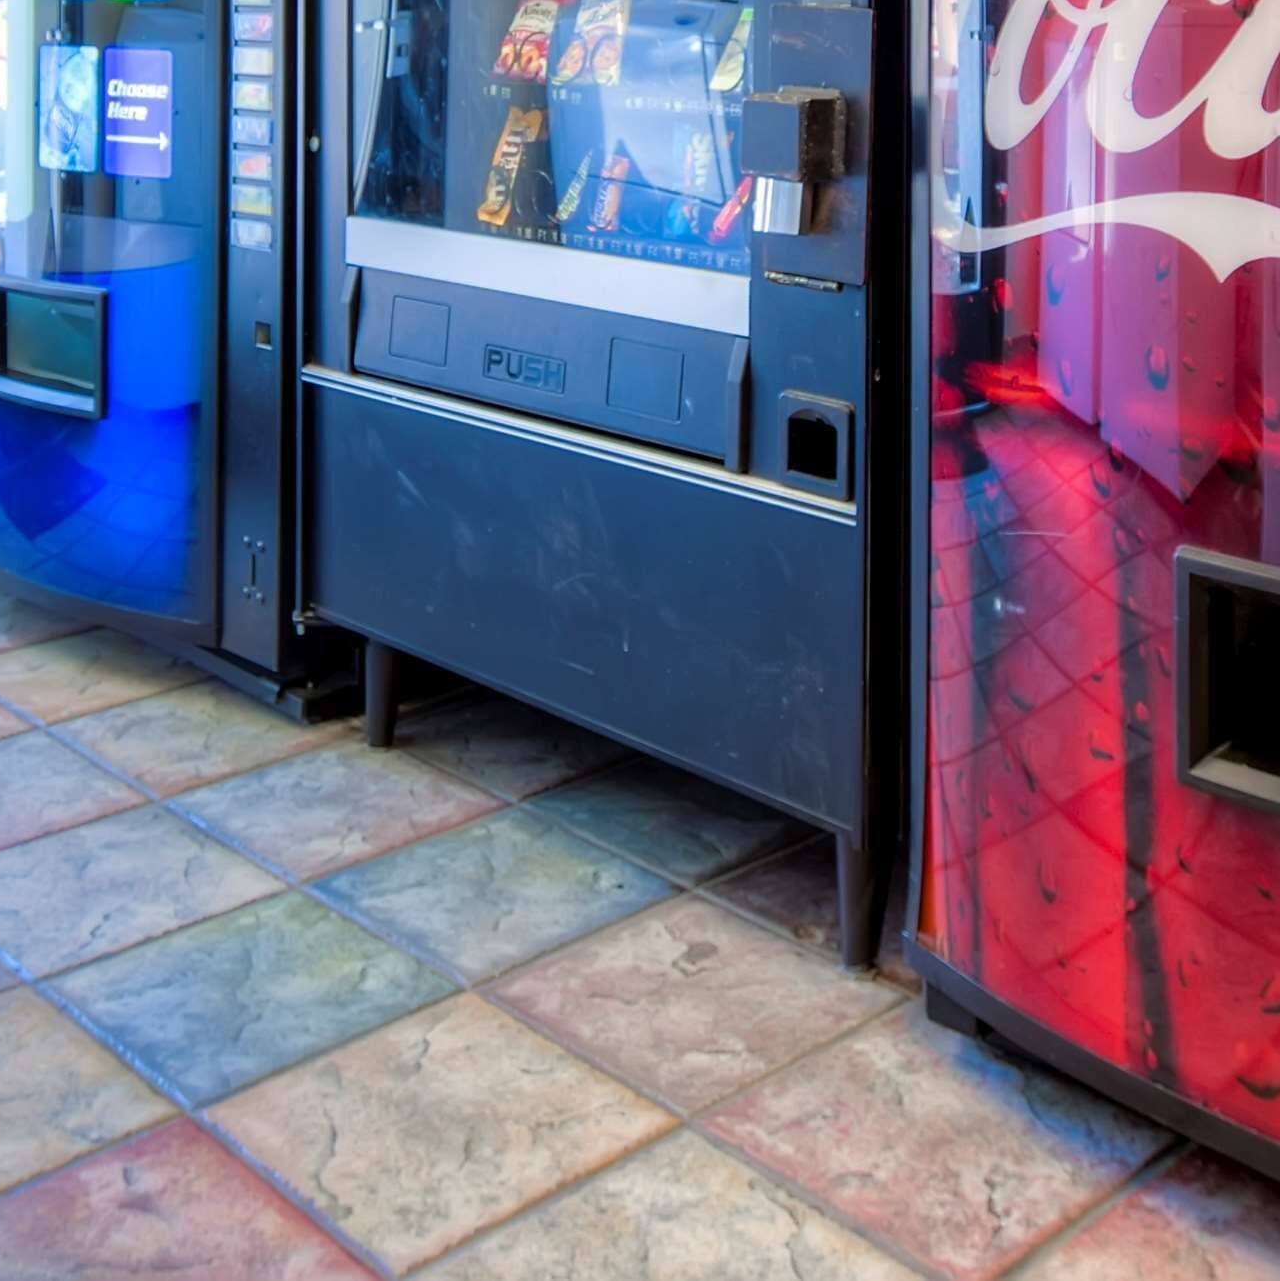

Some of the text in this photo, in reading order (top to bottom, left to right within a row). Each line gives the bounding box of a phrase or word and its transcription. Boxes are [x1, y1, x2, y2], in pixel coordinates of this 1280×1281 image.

[107, 79, 168, 99] Choose
[107, 101, 148, 121] Here
[485, 346, 564, 393] PUSH
